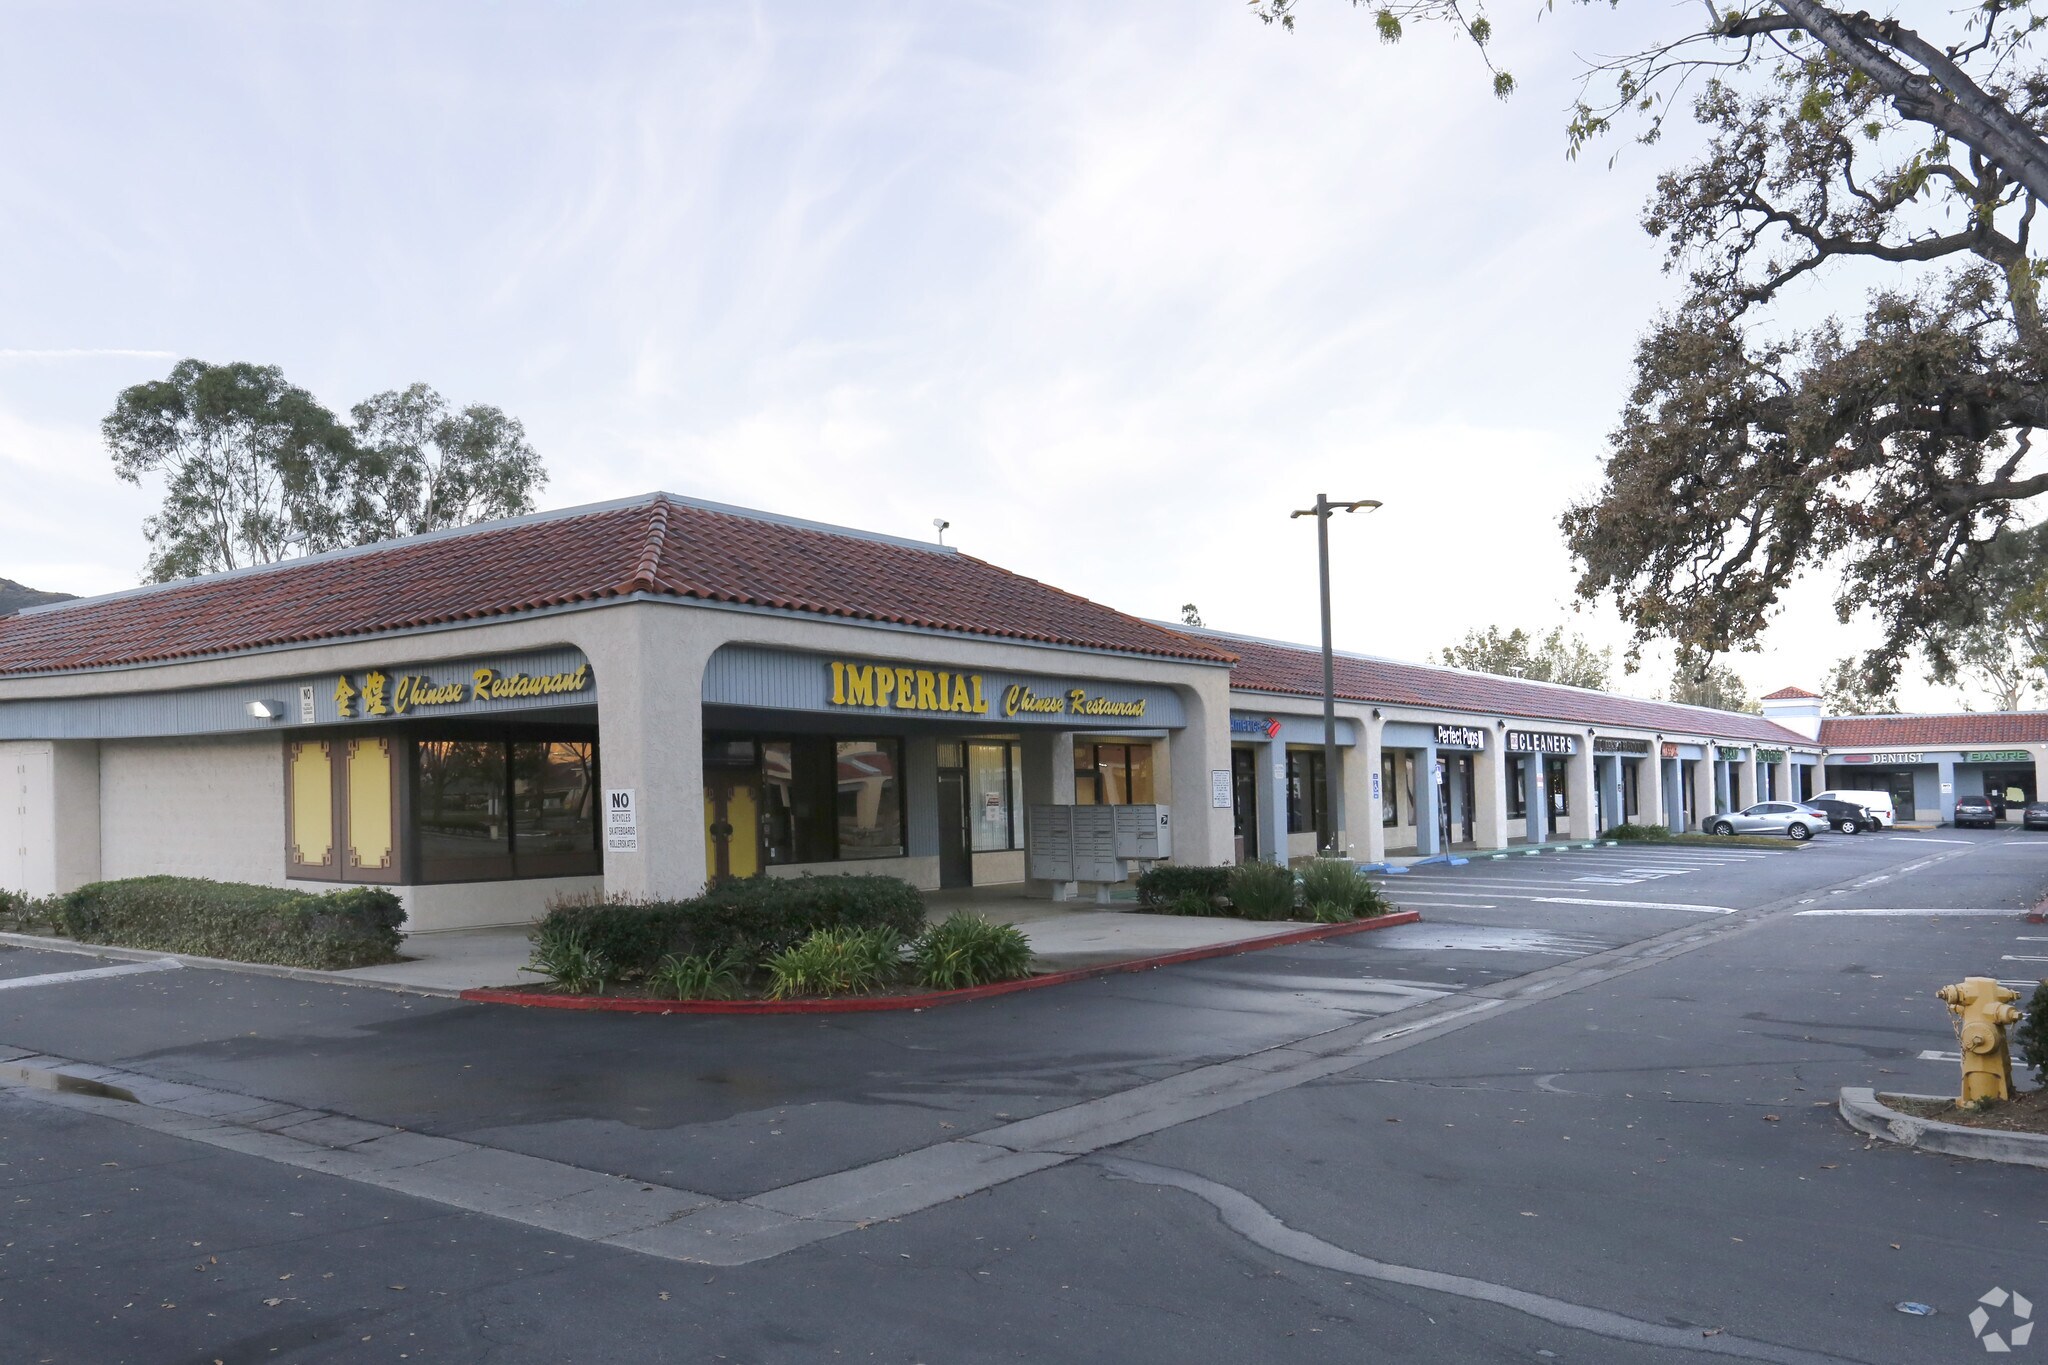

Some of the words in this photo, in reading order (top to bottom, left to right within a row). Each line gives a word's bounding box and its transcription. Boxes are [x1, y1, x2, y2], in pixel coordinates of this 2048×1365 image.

[394, 675, 464, 713] Chinese
[472, 664, 586, 701] Restaurant
[831, 661, 989, 714] IMPERIAL
[1005, 683, 1064, 717] Chinese
[1071, 689, 1146, 717] Restaurant
[1438, 725, 1462, 745] Perfect
[1462, 727, 1479, 749] Pups
[1519, 733, 1573, 752] CLEANERS
[1872, 752, 1924, 764] DENTIST
[1969, 750, 2029, 762] BARRE
[612, 792, 629, 808] NO
